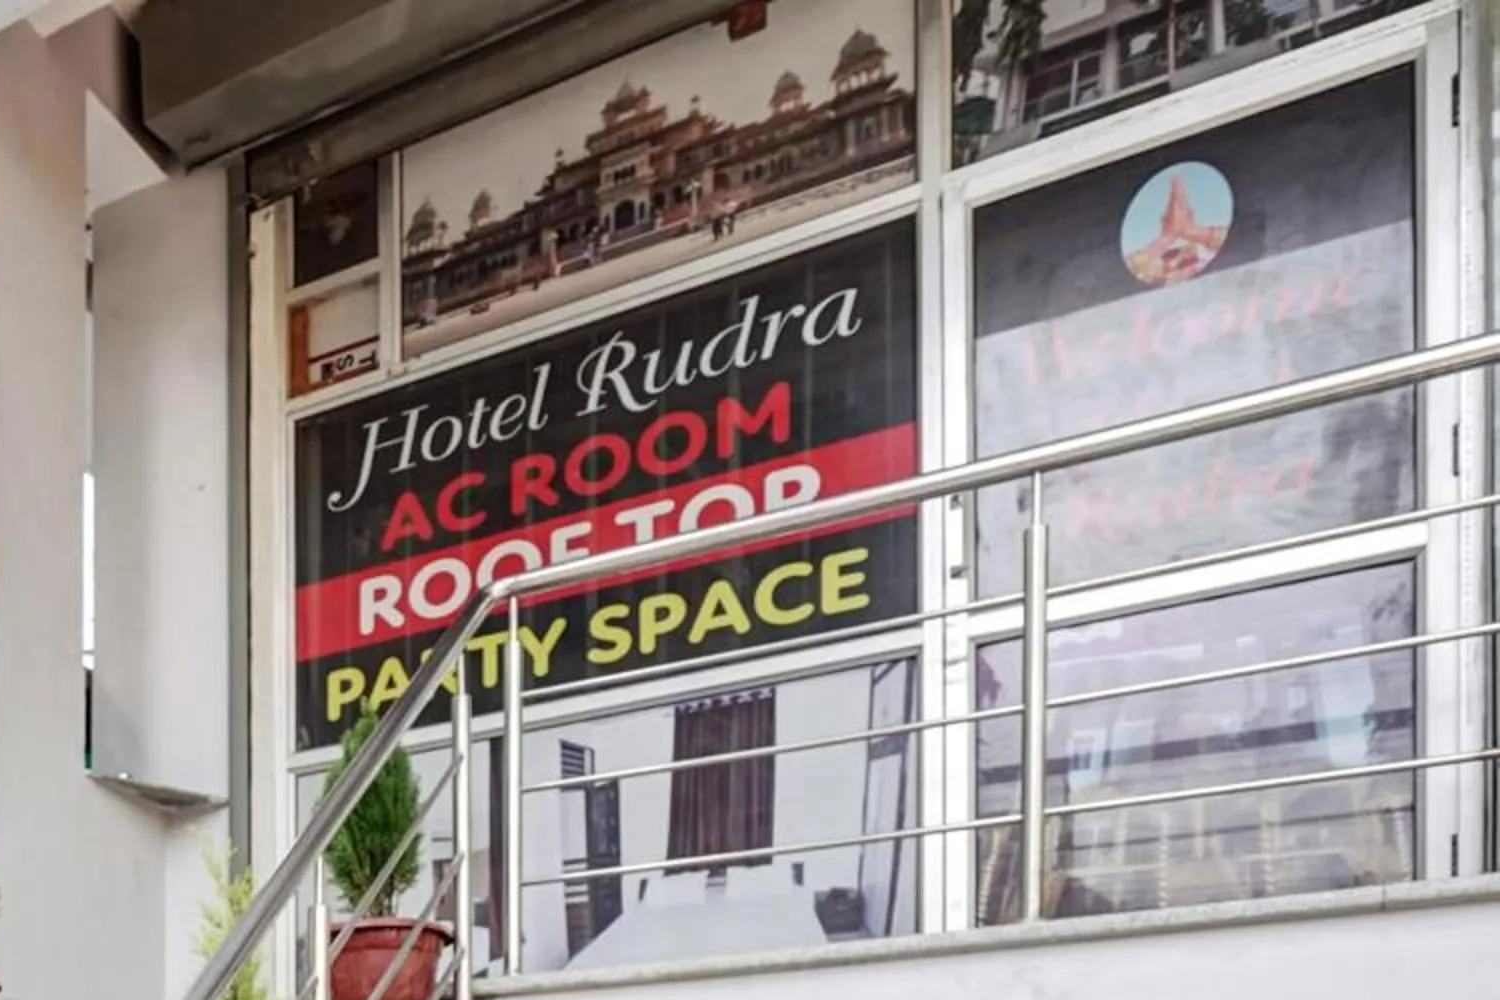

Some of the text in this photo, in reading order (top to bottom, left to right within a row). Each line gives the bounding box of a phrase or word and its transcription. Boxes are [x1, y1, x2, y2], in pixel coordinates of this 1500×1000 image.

[327, 365, 549, 512] Hotel
[575, 286, 861, 419] Rudra
[380, 380, 792, 553] AC ROOM
[326, 547, 870, 723] PATY SPACE
[358, 521, 593, 636] ROOF
